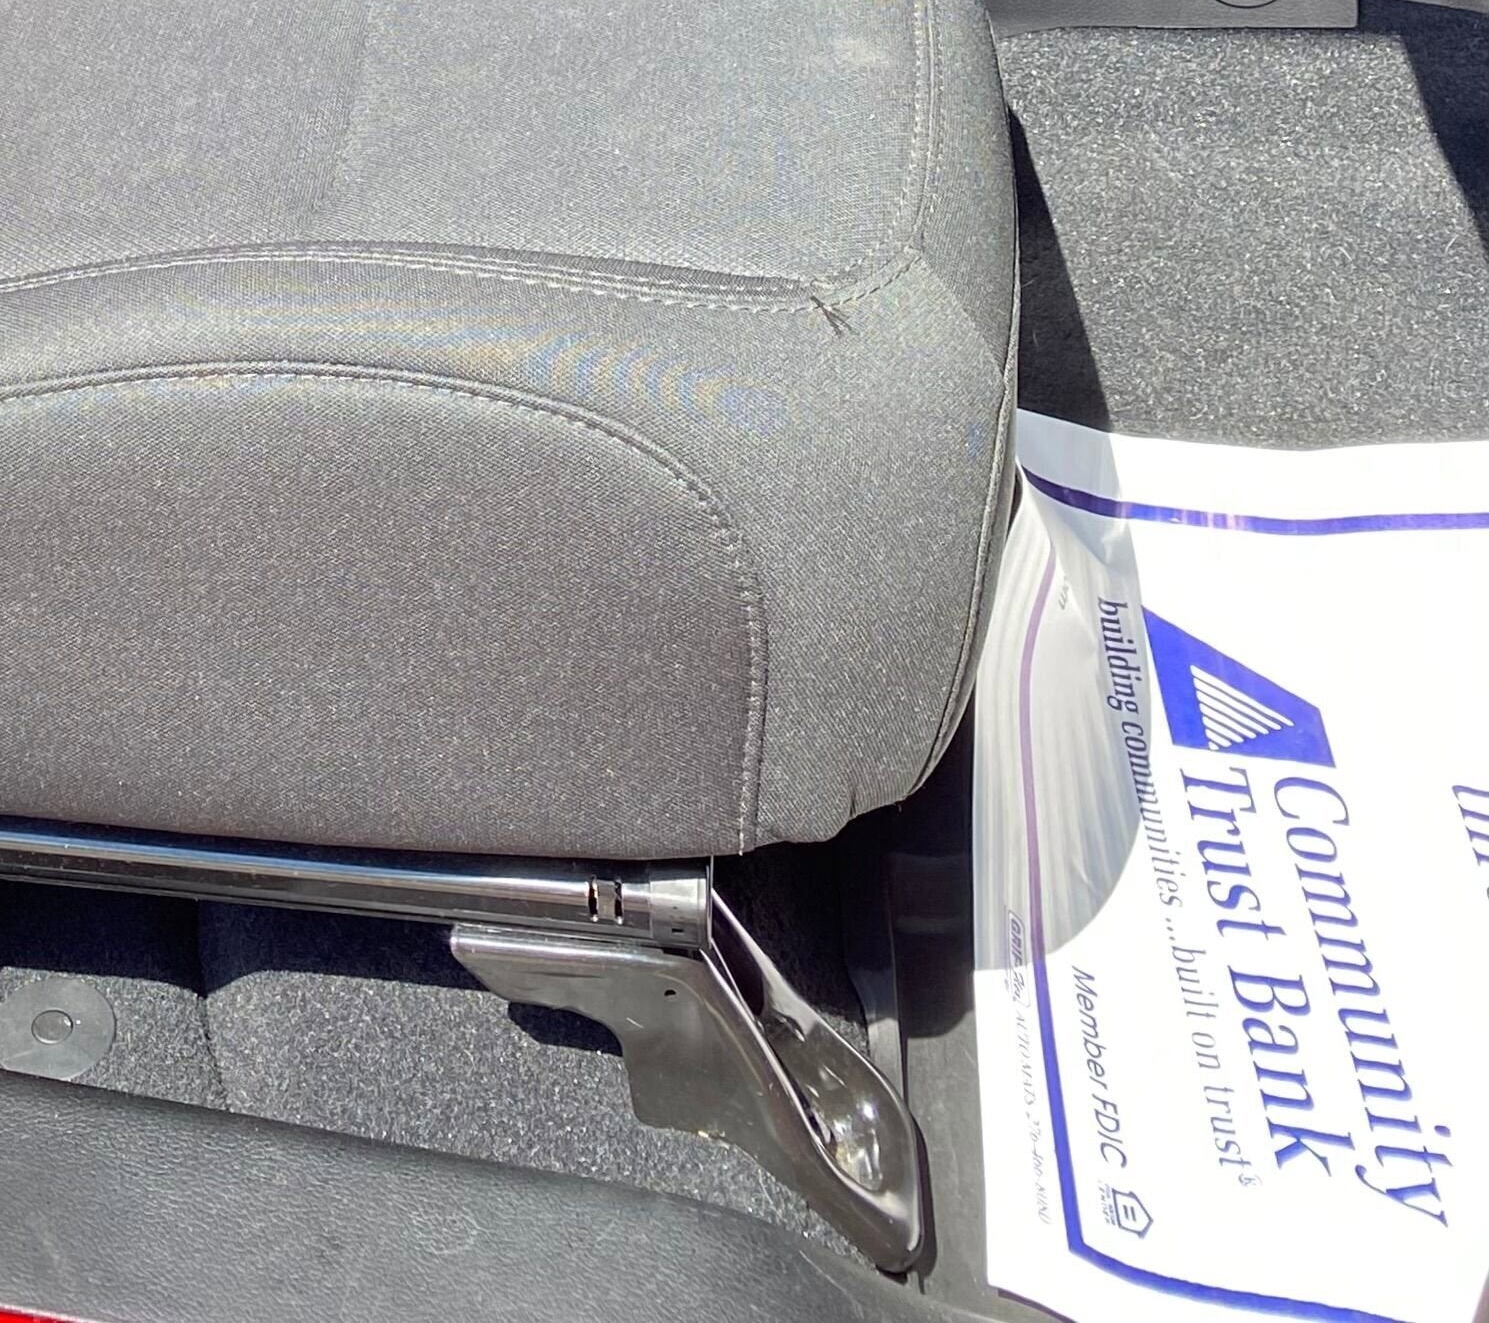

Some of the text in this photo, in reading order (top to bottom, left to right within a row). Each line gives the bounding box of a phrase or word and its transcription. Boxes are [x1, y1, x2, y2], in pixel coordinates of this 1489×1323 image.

[1098, 597, 1141, 714] building
[1122, 721, 1185, 907] communities
[1191, 1031, 1220, 1071] on
[1179, 766, 1356, 1177] Trust Bank
[1275, 777, 1449, 1227] Community
[1072, 966, 1128, 1169] Member FDIC
